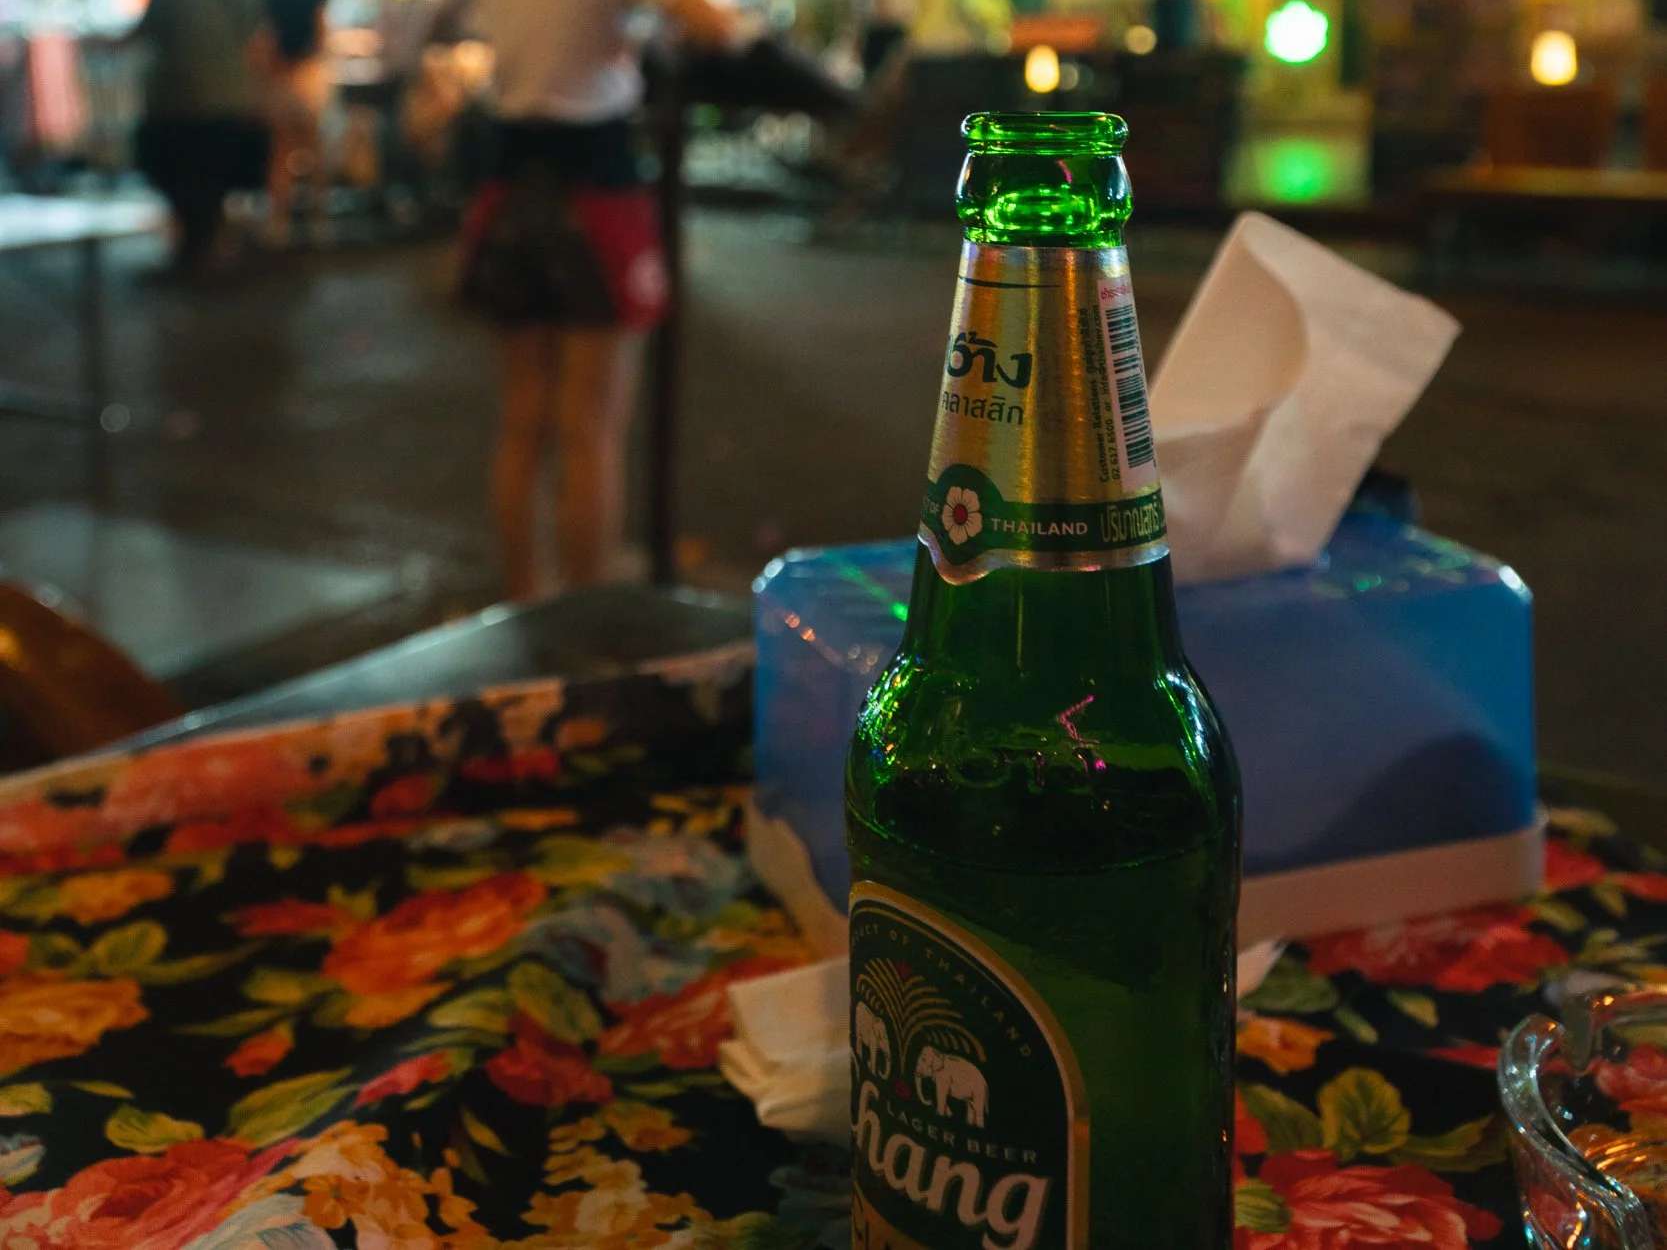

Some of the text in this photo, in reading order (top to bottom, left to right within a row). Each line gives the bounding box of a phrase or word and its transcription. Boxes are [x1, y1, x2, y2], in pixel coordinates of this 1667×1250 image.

[991, 518, 1088, 535] THAILAND
[924, 946, 1032, 1057] THAILAND
[851, 1081, 1050, 1250] hang
[886, 1101, 1037, 1164] LAGER BEER
